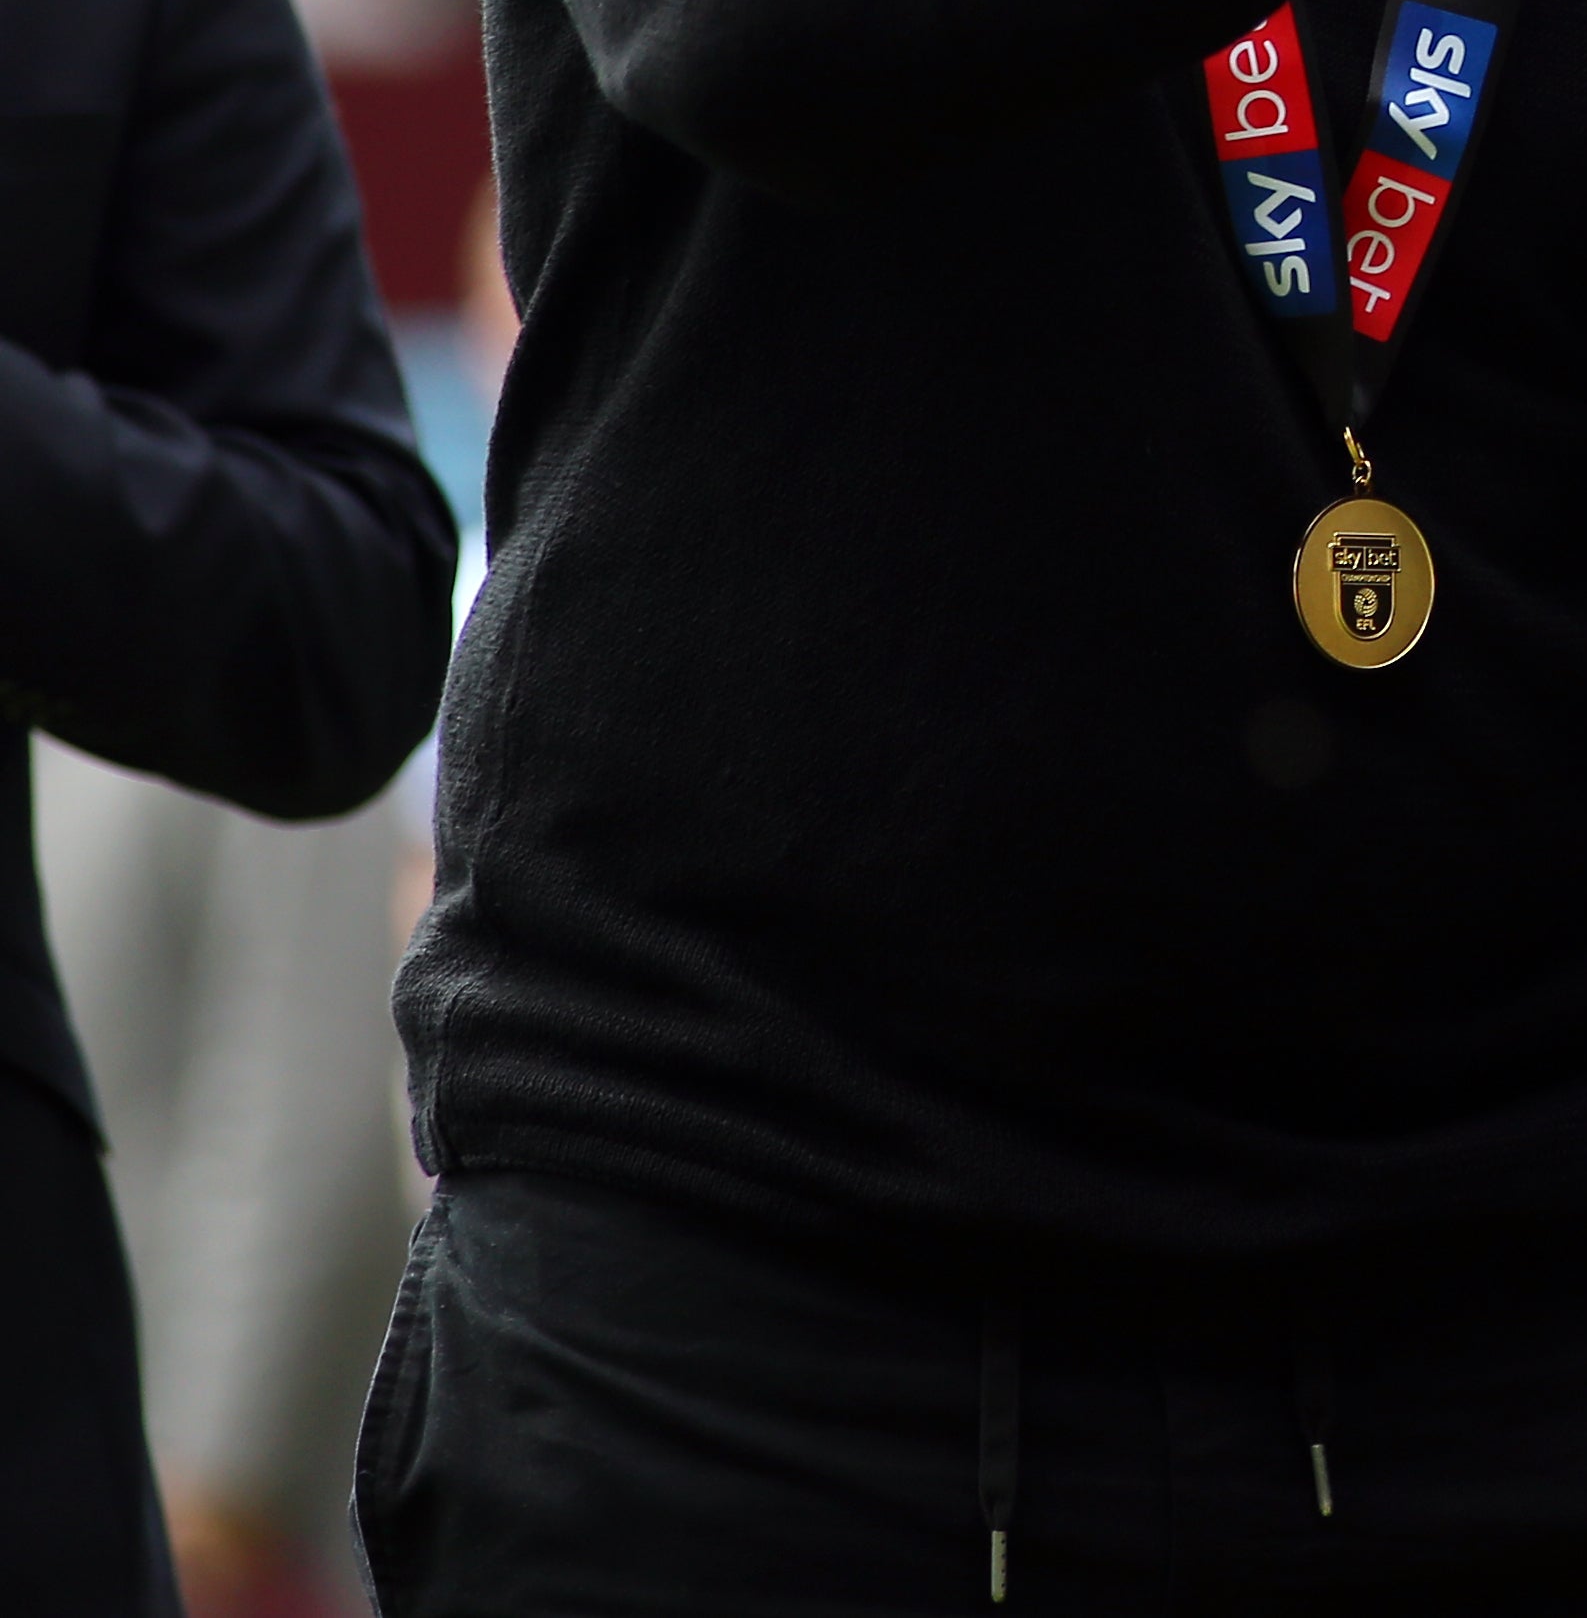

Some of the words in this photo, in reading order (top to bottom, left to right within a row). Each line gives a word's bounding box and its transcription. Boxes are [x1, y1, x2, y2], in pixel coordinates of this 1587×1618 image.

[1225, 20, 1288, 141] be
[1389, 28, 1471, 159] sky
[1245, 172, 1316, 297] sky
[1335, 548, 1361, 569] sky
[1368, 548, 1397, 565] bet
